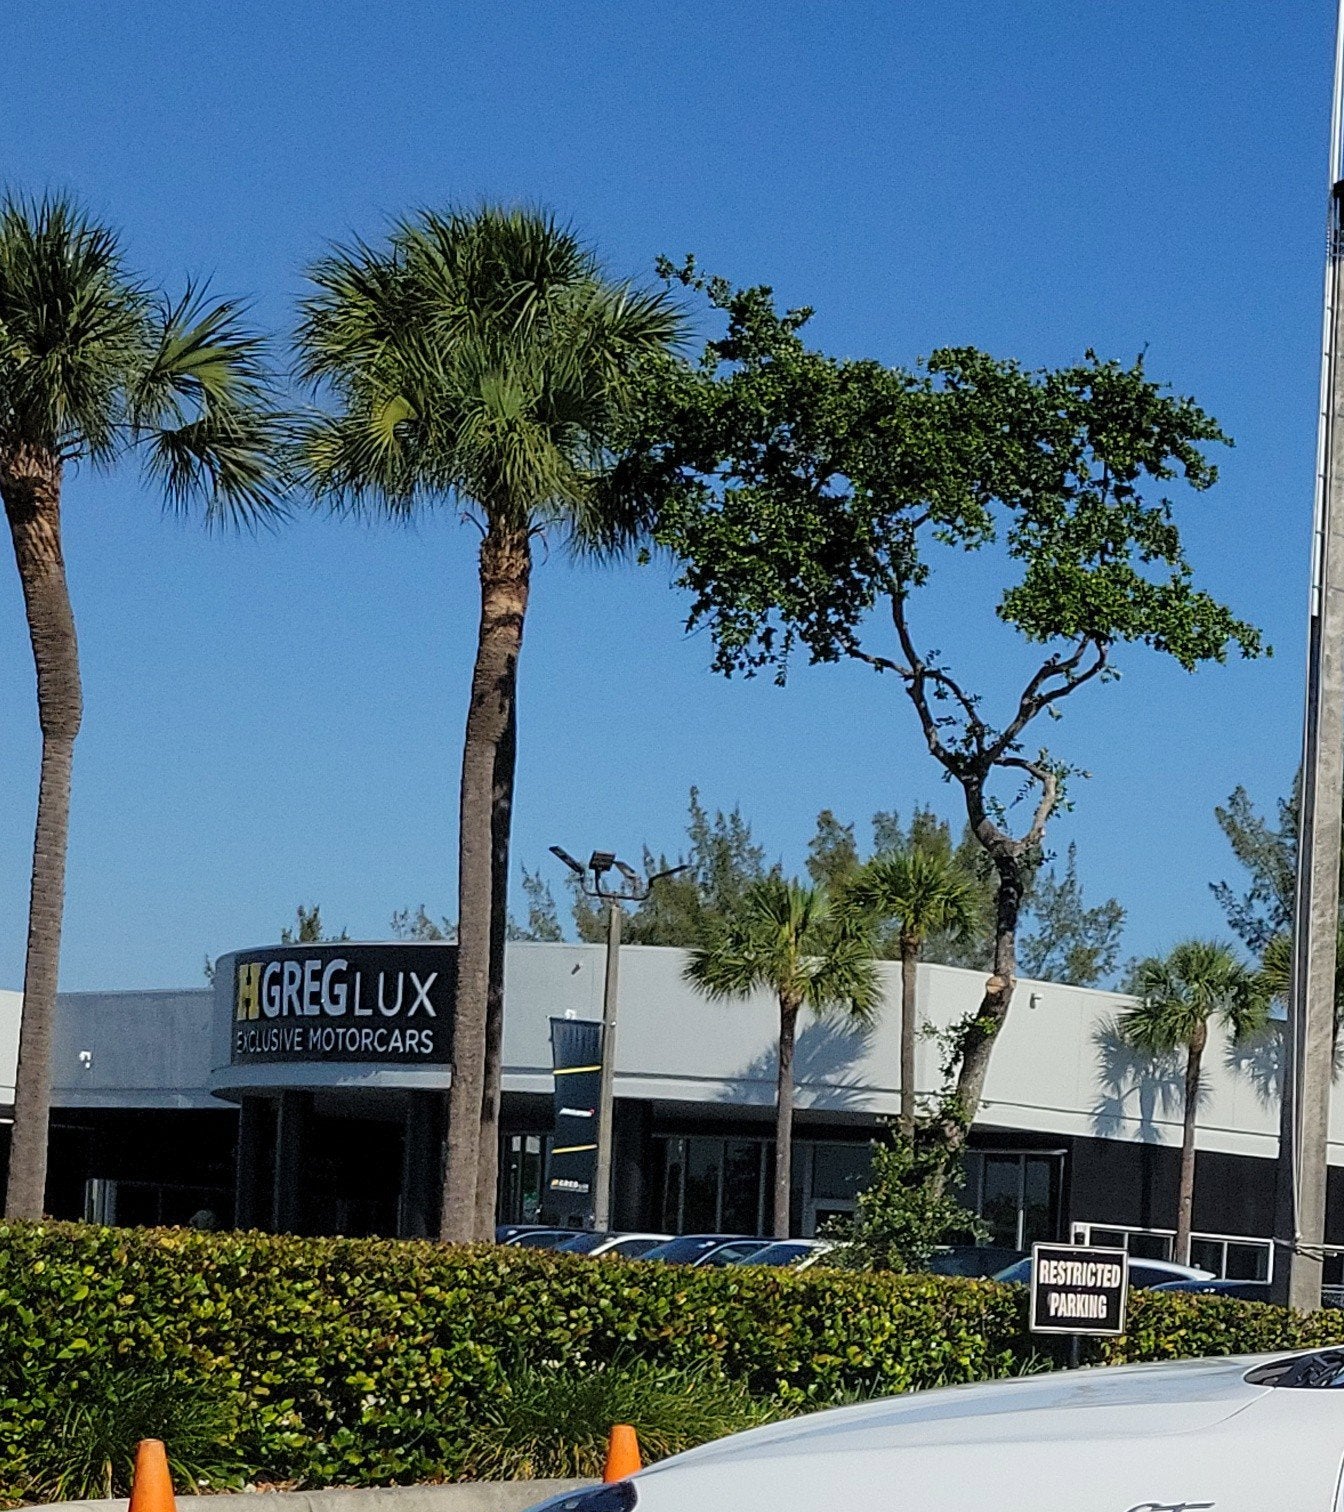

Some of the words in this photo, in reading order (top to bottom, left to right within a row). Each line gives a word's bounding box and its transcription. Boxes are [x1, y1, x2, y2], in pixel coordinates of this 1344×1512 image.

[237, 1027, 304, 1054] EXCLUSIVE
[308, 1027, 434, 1055] MOTORCARS
[1040, 1259, 1120, 1289] RESTRICTED
[1049, 1292, 1107, 1319] PARKING
